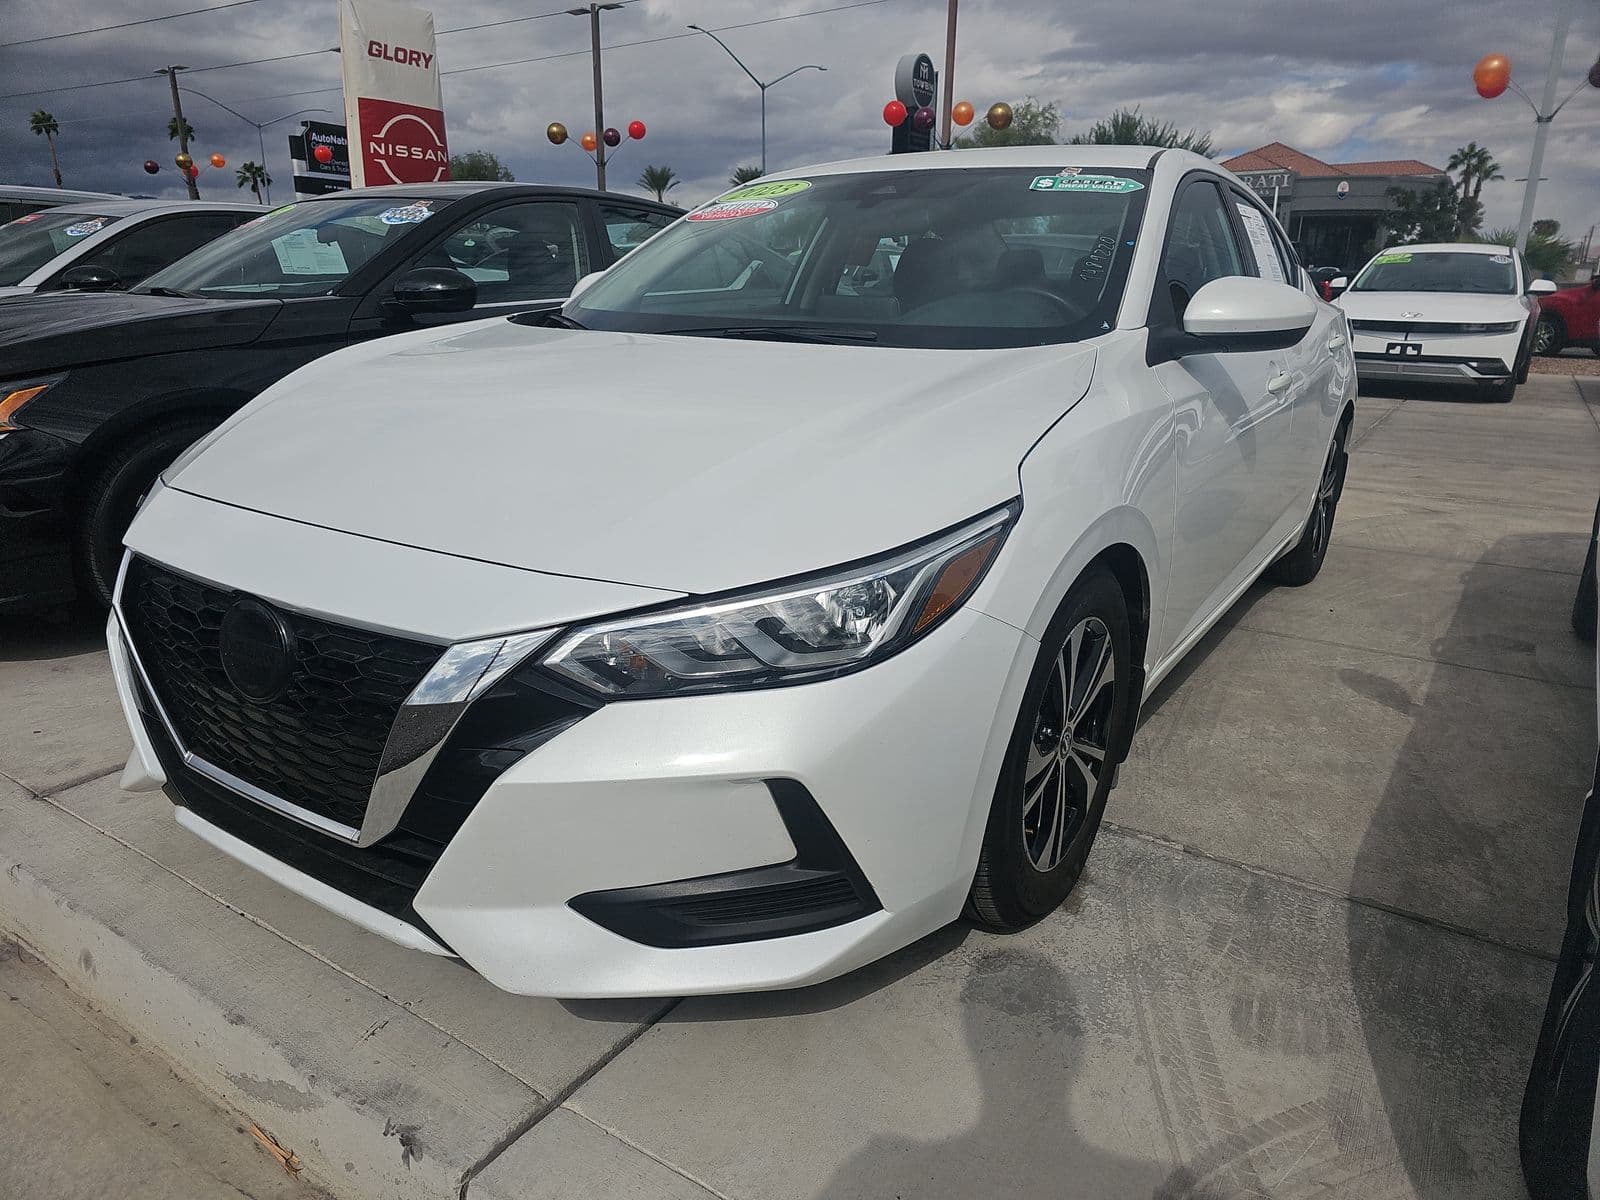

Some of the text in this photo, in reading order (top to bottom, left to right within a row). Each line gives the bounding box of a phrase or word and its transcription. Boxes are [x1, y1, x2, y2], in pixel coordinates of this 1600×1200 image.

[368, 40, 433, 69] GLORY
[370, 142, 448, 163] NISSAN
[1244, 175, 1290, 189] RATI
